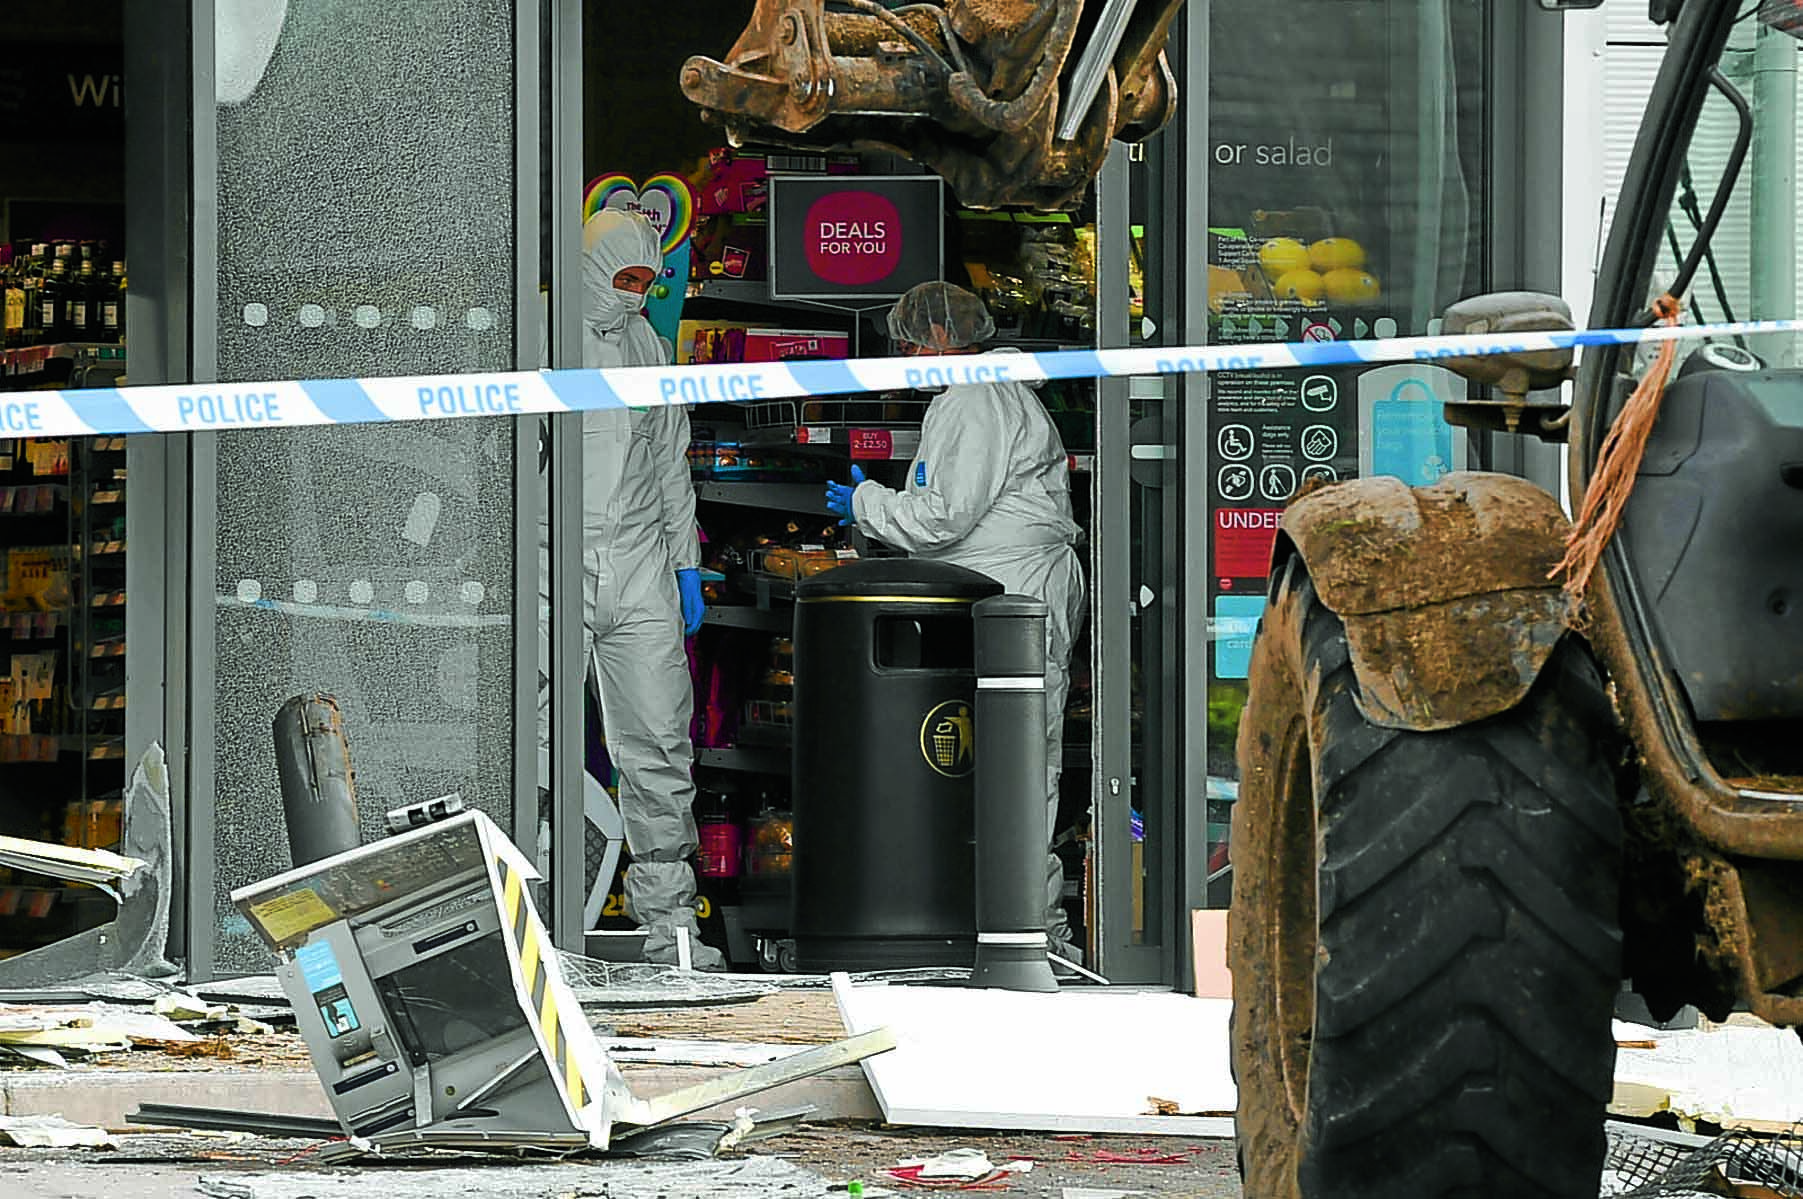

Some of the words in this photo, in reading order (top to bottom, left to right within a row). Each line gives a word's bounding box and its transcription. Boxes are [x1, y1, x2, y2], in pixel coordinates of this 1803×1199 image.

[1215, 143, 1247, 164] or
[1255, 135, 1333, 166] salad
[820, 221, 886, 239] DEALS
[820, 241, 851, 255] FOR
[853, 241, 886, 255] YOU
[176, 392, 283, 424] POLICE
[416, 383, 522, 415] POLICE
[659, 374, 765, 404] POLICE
